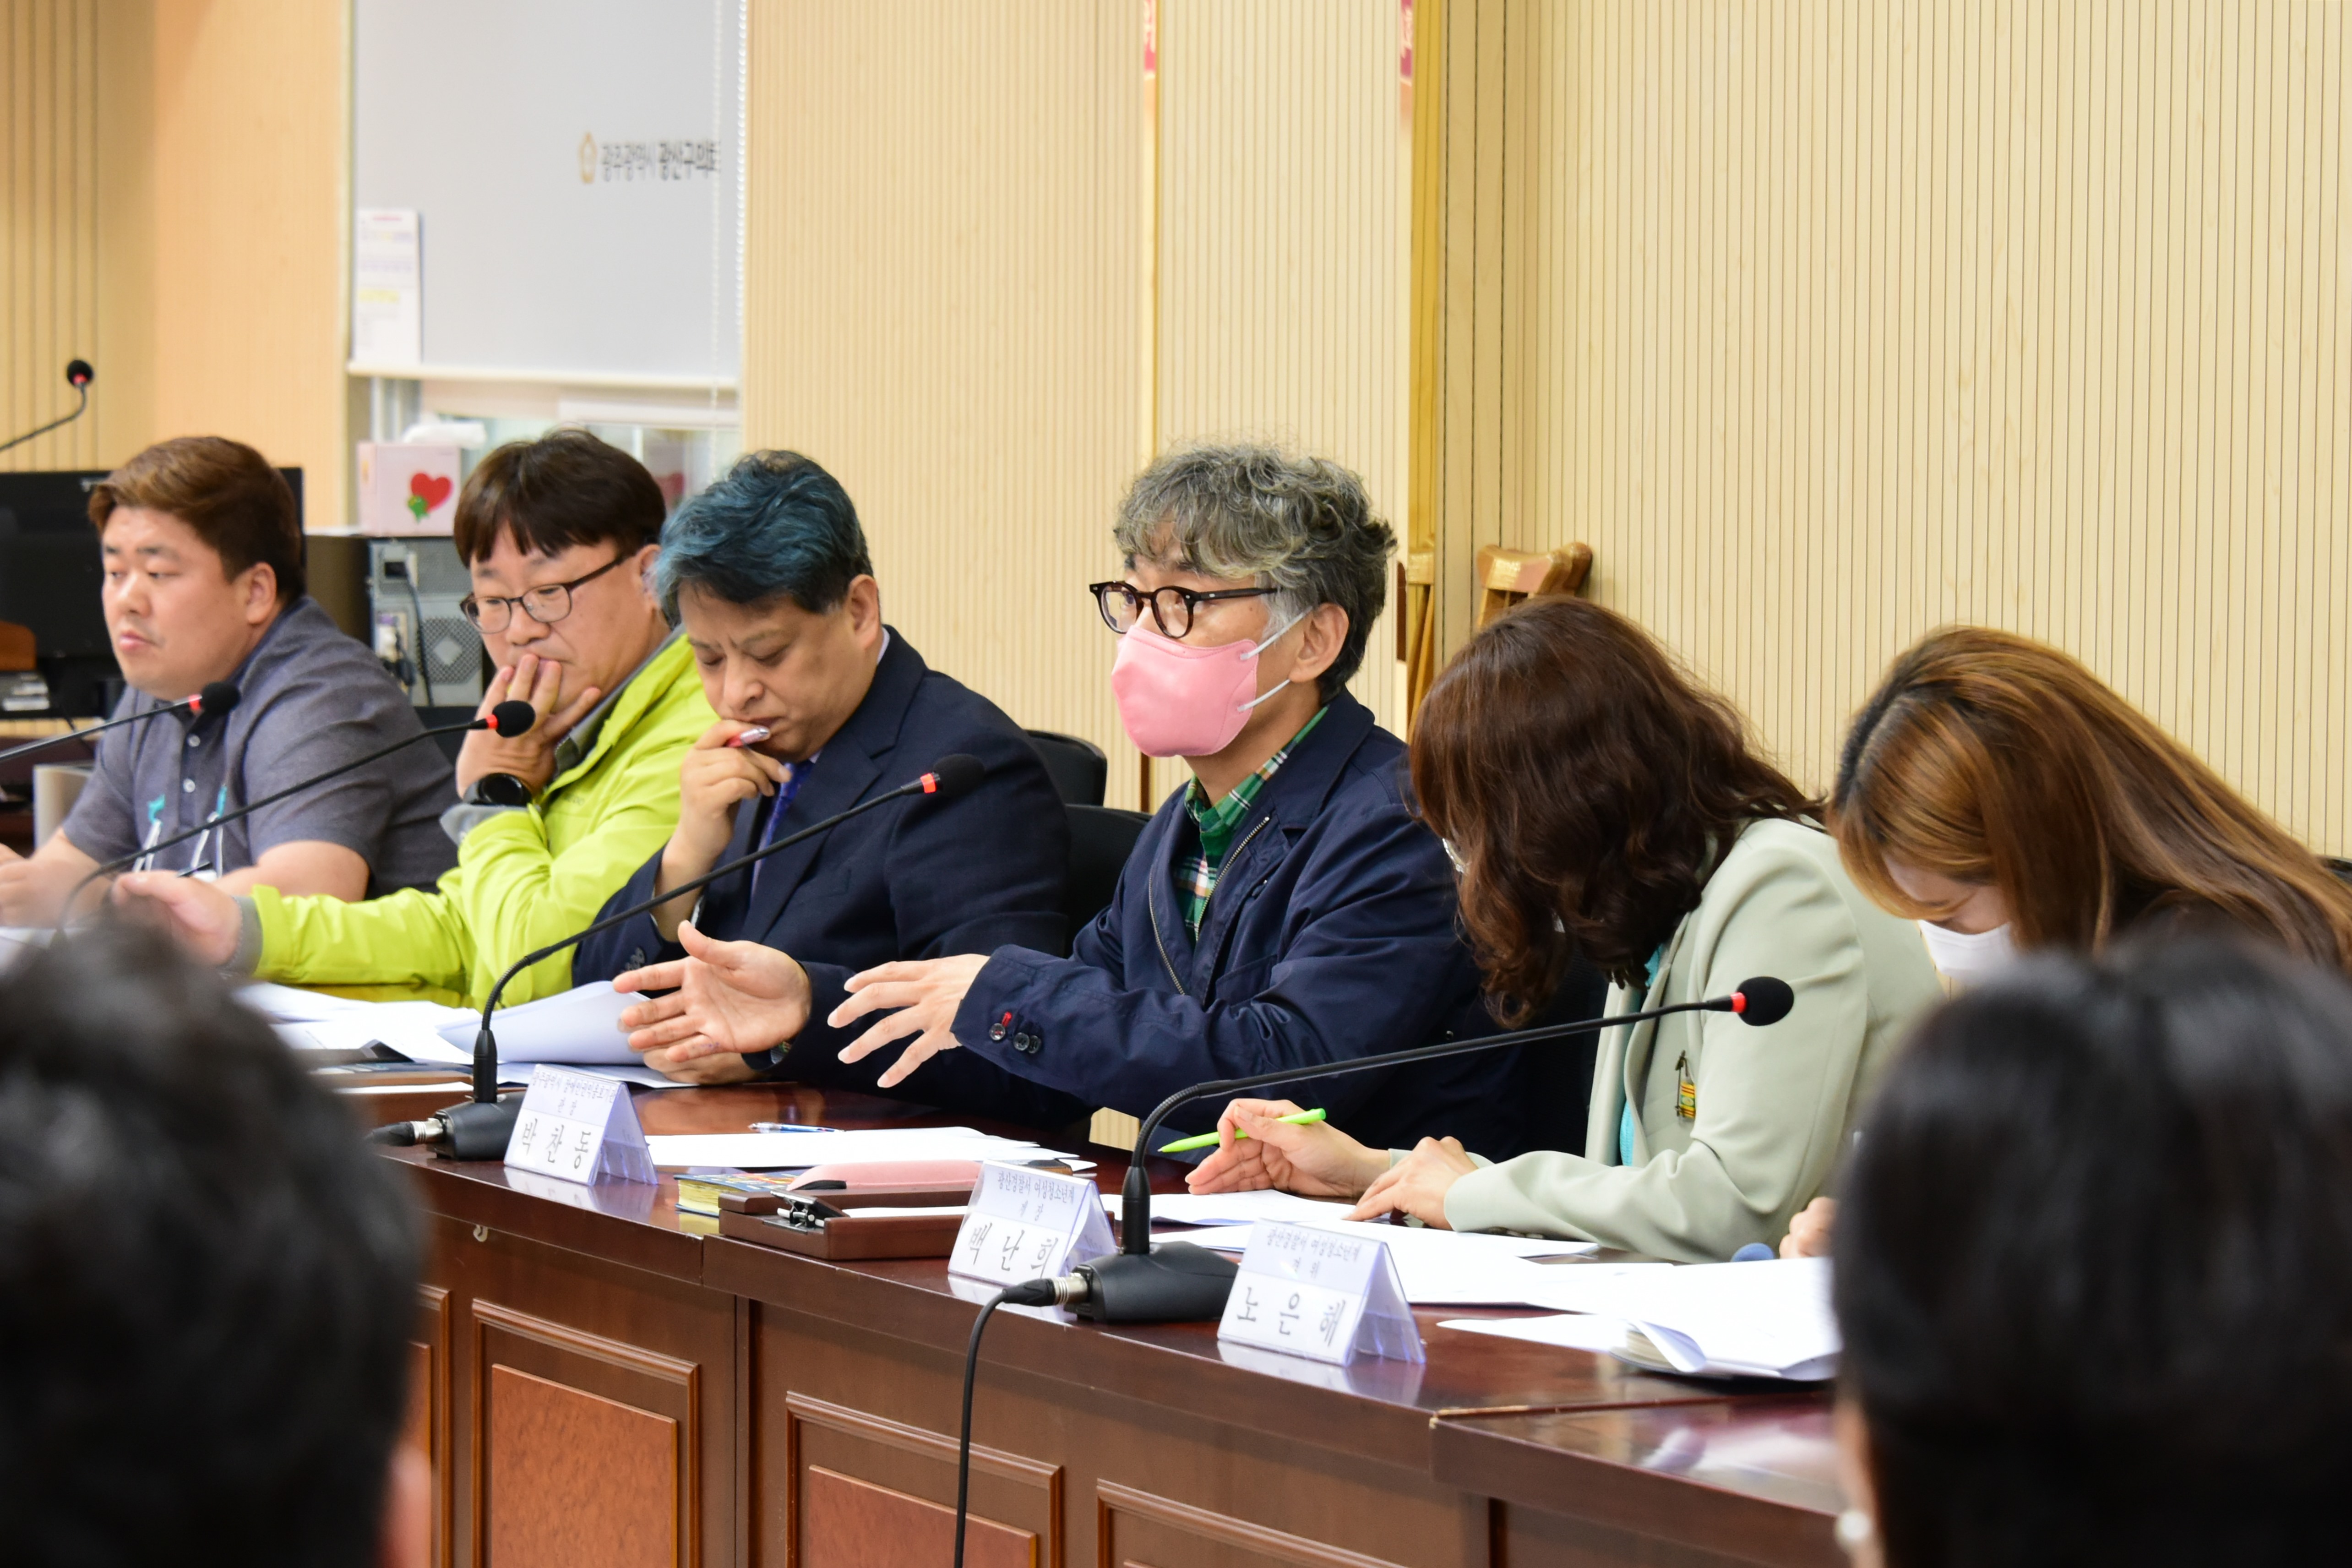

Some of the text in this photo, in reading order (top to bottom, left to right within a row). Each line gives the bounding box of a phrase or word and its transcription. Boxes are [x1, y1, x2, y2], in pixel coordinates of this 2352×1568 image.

[997, 1171, 1075, 1205] 광산경찰서 여성청소년계
[1267, 1226, 1363, 1263] 광산경찰서 여성청소년계
